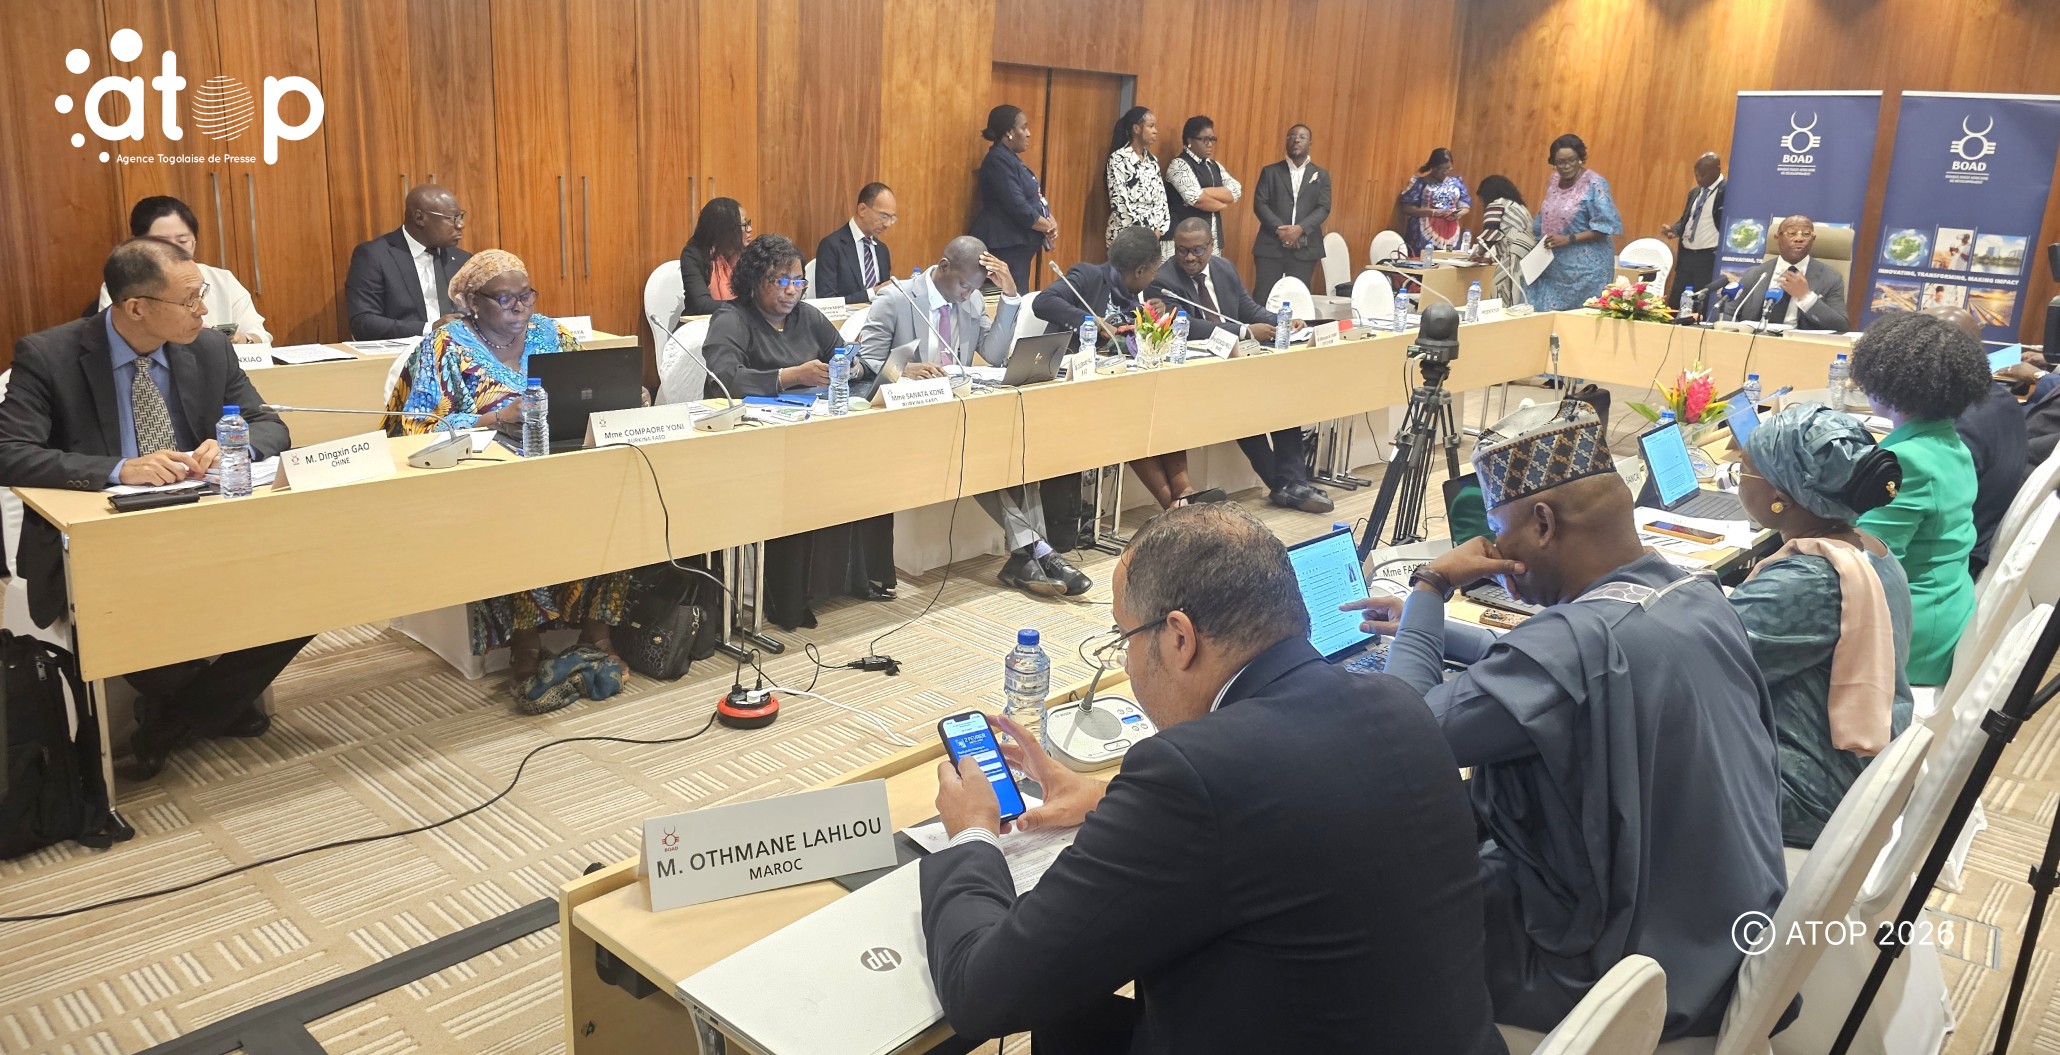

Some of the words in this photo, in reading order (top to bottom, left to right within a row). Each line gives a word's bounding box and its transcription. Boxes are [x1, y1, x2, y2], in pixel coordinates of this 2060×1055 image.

[1782, 154, 1814, 164] BOAD
[1952, 160, 1987, 171] BOAD
[906, 390, 929, 399] SANATA
[930, 388, 945, 396] KONE
[604, 431, 623, 439] Mme
[624, 425, 665, 437] COMPAORE
[666, 423, 685, 431] YONI
[305, 454, 317, 464] M.
[318, 447, 350, 461] Dingxin
[351, 442, 370, 454] GAO
[331, 457, 351, 468] CHINE
[1382, 568, 1402, 578] Mme
[656, 858, 684, 879] M.
[689, 834, 797, 872] OTHMANE
[802, 816, 882, 849] LAHLOU
[749, 858, 803, 881] MAROC
